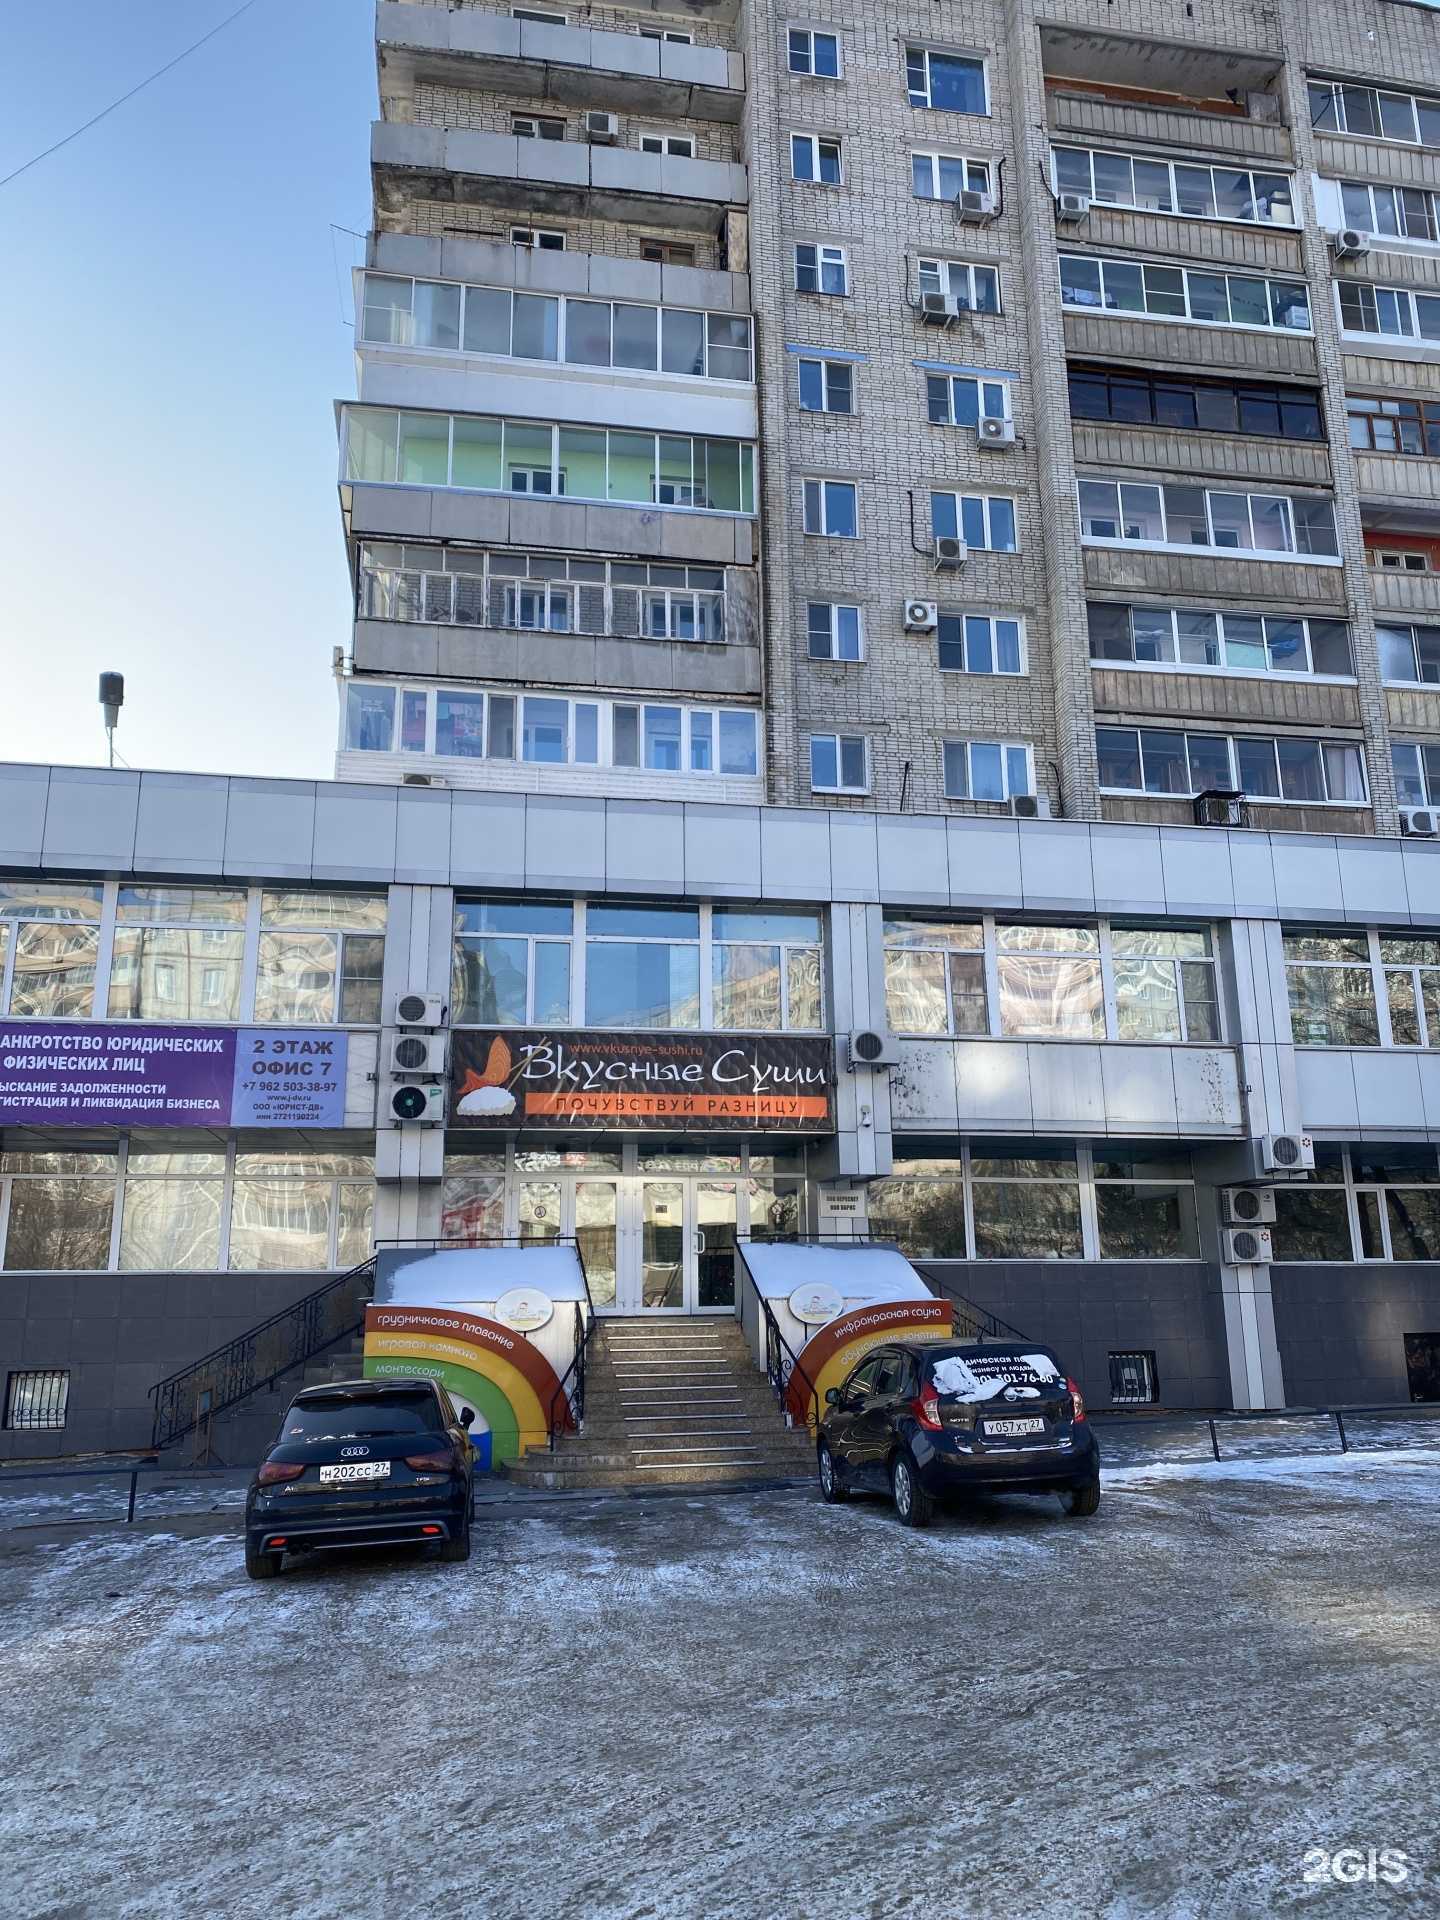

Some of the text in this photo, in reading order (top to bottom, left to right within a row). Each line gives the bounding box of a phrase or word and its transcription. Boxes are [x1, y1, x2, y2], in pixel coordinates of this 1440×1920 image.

[0, 1034, 223, 1053] АНКРОТСТВО ЮРИДИЧЕСКИХ
[253, 1040, 333, 1054] 2 ЭТАЖ
[569, 1043, 703, 1056] www.vkusnye-sushi.ru
[4, 1055, 145, 1074] ФИЗИЧЕСКИХ ЛИЦ
[252, 1061, 332, 1075] ОФИС 7
[519, 1044, 828, 1093] Вкусные Суши
[60, 1082, 166, 1094] ЗАДОЛЖЕННОСТИ
[242, 1081, 337, 1092] +7 962 503-38-97
[71, 1098, 79, 1107] И
[82, 1097, 163, 1110] ЛИКВИДАЦИЯ
[166, 1098, 220, 1110] БИЗНЕСА
[253, 1103, 270, 1111] ООО
[555, 1096, 799, 1114] ПОЧУВСТВУЙ РАЗНИЦУ
[834, 1308, 942, 1339] инфракрасная сауна
[377, 1314, 514, 1350] грудничковое плавание
[375, 1365, 445, 1379] монтессори
[988, 1419, 1040, 1433] У057ХТ 27
[324, 1463, 386, 1478] Н202СС 27
